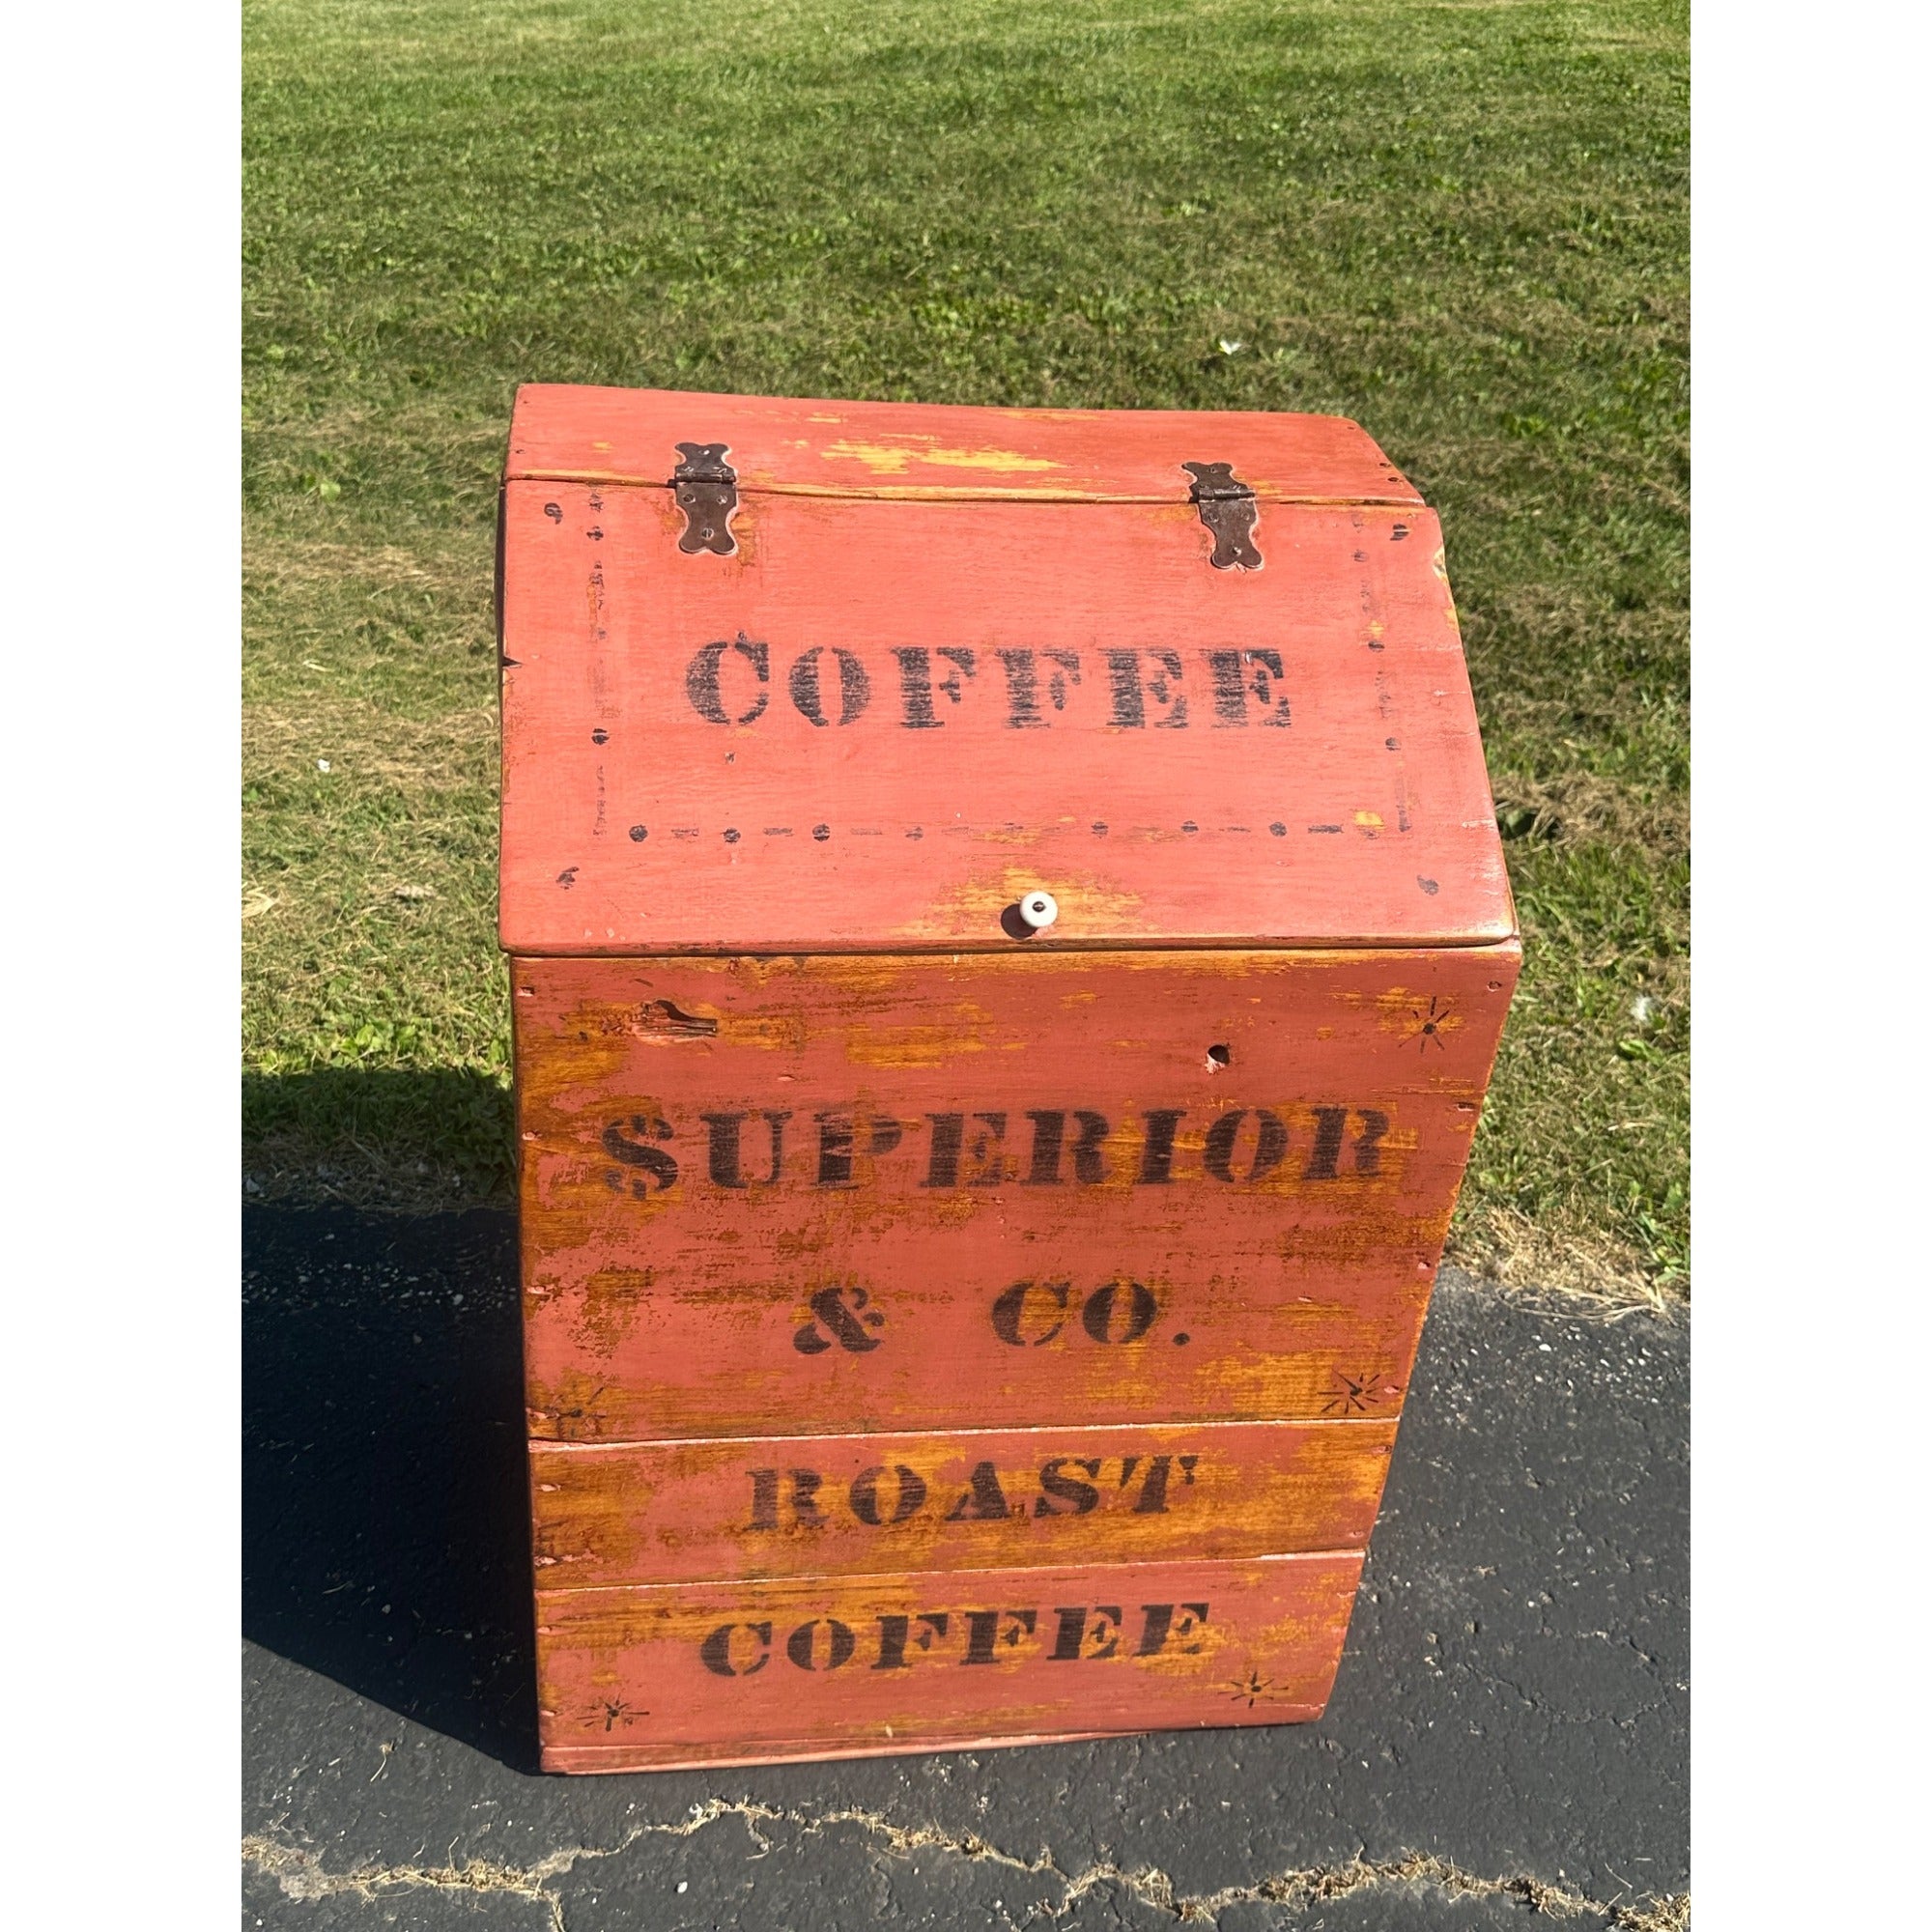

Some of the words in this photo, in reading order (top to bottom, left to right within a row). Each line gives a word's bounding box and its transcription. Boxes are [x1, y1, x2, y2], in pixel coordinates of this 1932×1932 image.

[686, 640, 1291, 728] COFFEE
[601, 1106, 1397, 1199] SUPERIOR
[793, 1286, 885, 1354] &
[991, 1279, 1191, 1347] CO.
[745, 1455, 1199, 1532] ROAST
[699, 1603, 1210, 1676] COFFEE
